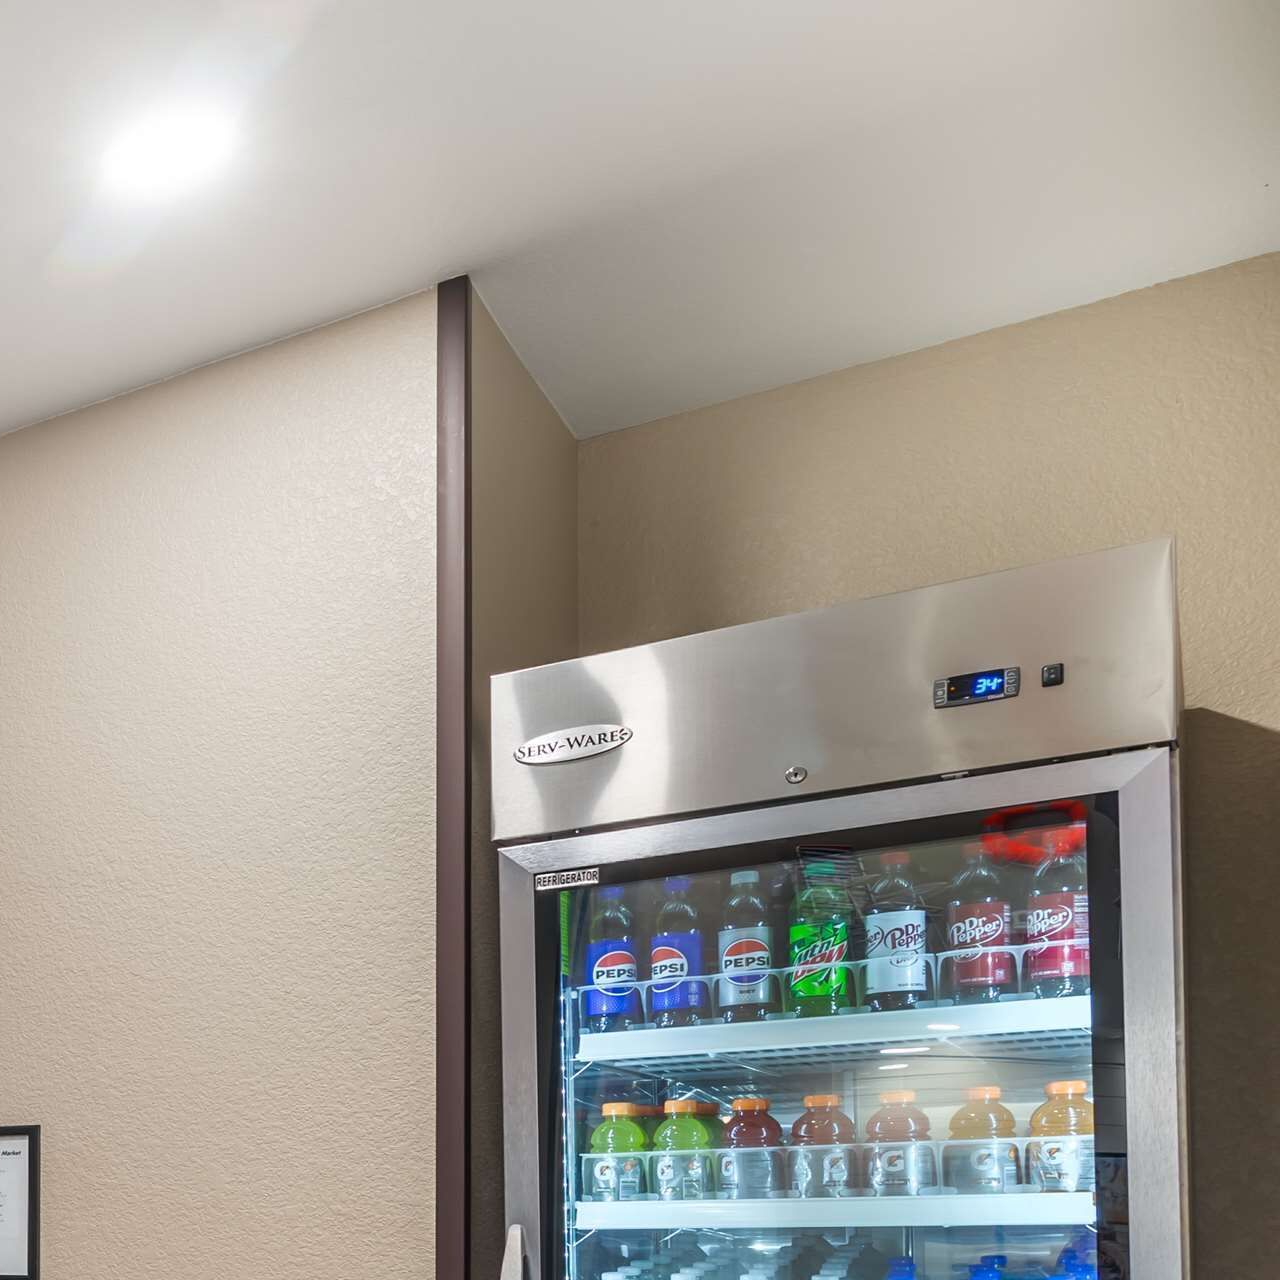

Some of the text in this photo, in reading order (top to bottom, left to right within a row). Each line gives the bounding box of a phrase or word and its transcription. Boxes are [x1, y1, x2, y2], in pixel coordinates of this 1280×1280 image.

[517, 729, 619, 760] SERV-WARE
[537, 870, 598, 887] REFRIGERATOR
[1031, 908, 1052, 923] Dr
[905, 923, 921, 936] Dr
[952, 920, 1000, 945] Pepper
[965, 917, 986, 932] Dr
[596, 968, 635, 979] PEPS
[653, 963, 684, 975] EPSI
[881, 1151, 905, 1172] G
[971, 1149, 995, 1170] G
